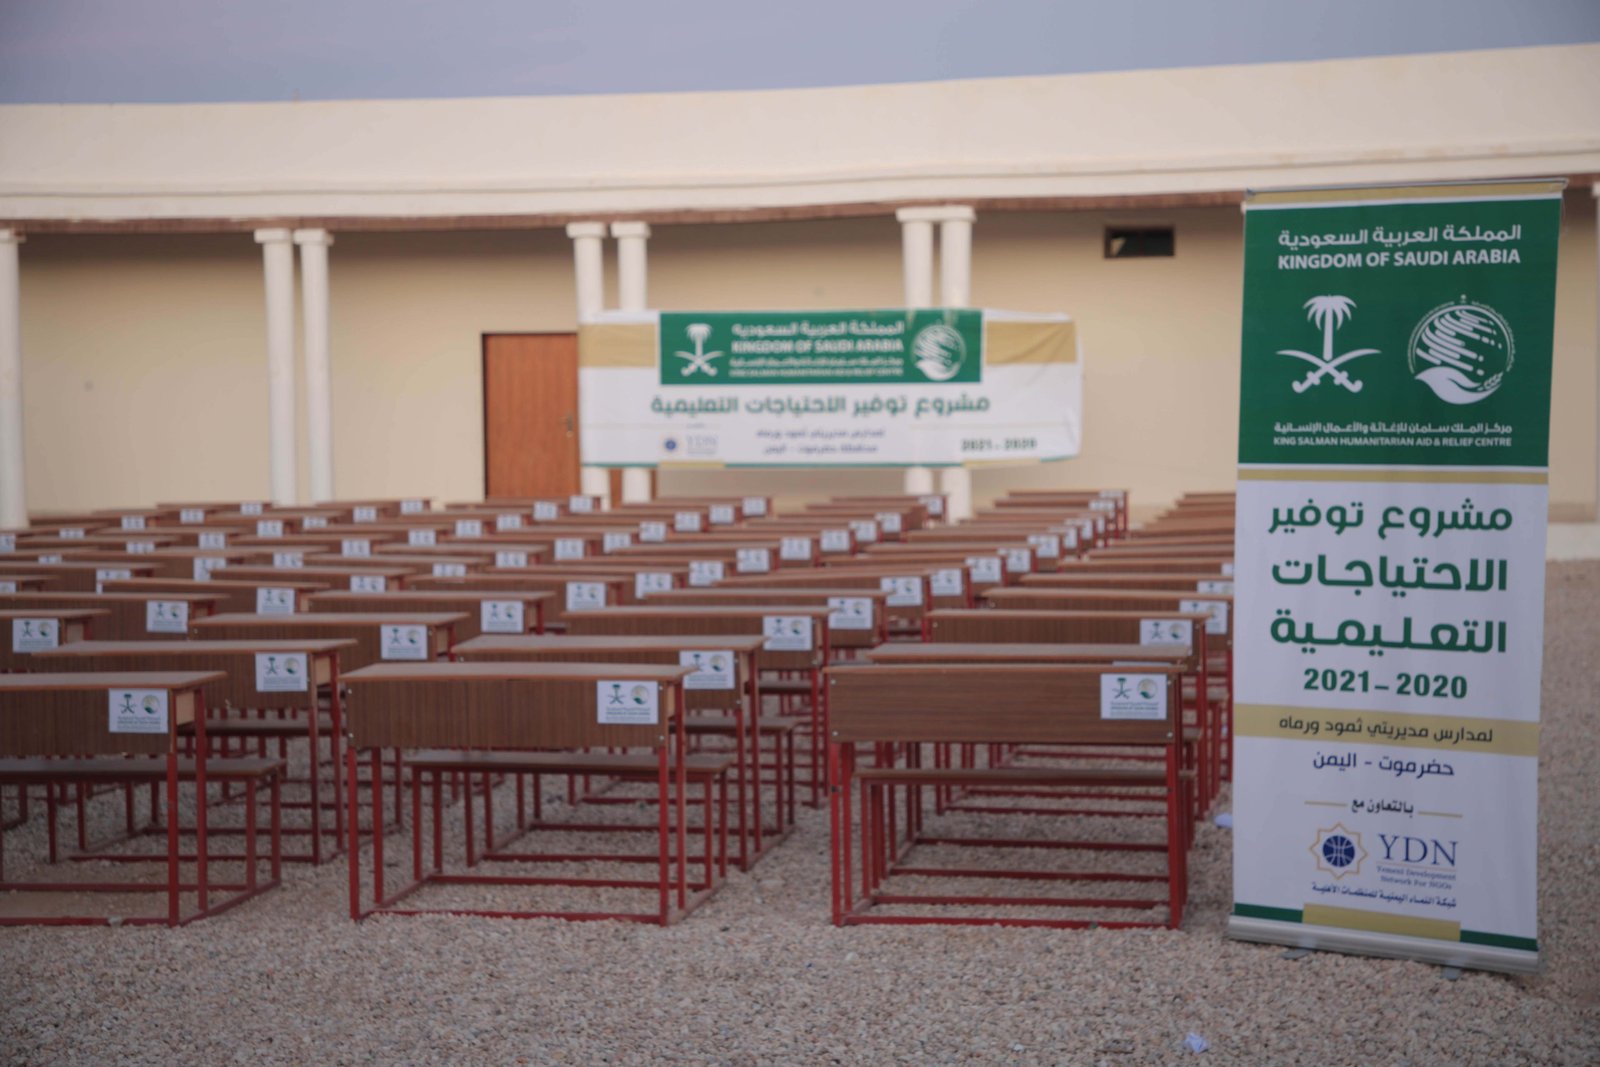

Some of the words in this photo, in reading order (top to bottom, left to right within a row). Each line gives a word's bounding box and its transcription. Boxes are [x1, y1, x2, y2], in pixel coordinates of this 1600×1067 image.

[1278, 229, 1368, 250] السعودية
[1372, 226, 1438, 247] العربية
[1443, 224, 1522, 242] المملكة
[1278, 253, 1362, 269] KINGDOM
[1366, 252, 1391, 267] OF
[1394, 250, 1449, 266] SAUDI
[1452, 248, 1521, 265] ARABIA
[651, 395, 738, 417] التعليمية
[745, 395, 846, 416] الاحتياجات
[853, 396, 907, 418] توفير
[914, 396, 990, 419] مشروع
[1273, 437, 1296, 446] KING
[1297, 437, 1338, 446] SALMAN
[1340, 437, 1415, 446] HUMANITARIAN
[1416, 438, 1432, 446] AID
[1442, 437, 1473, 446] RELIEF
[1475, 437, 1512, 446] CENTRE
[1268, 498, 1364, 535] توفير
[1378, 498, 1513, 540] مشروع
[1271, 554, 1508, 598] الاحتياجات
[1270, 608, 1507, 657] التعليمية
[1278, 717, 1320, 734] ورماه
[1324, 717, 1362, 735] ثمود
[1366, 725, 1429, 741] مديريتي
[1433, 729, 1493, 746] لمدارس
[1313, 751, 1357, 772] اليمن
[1379, 755, 1455, 778] حضرموت
[1351, 799, 1364, 813] مع
[1367, 799, 1414, 818] بالتعاون
[1377, 833, 1458, 867] YDN
